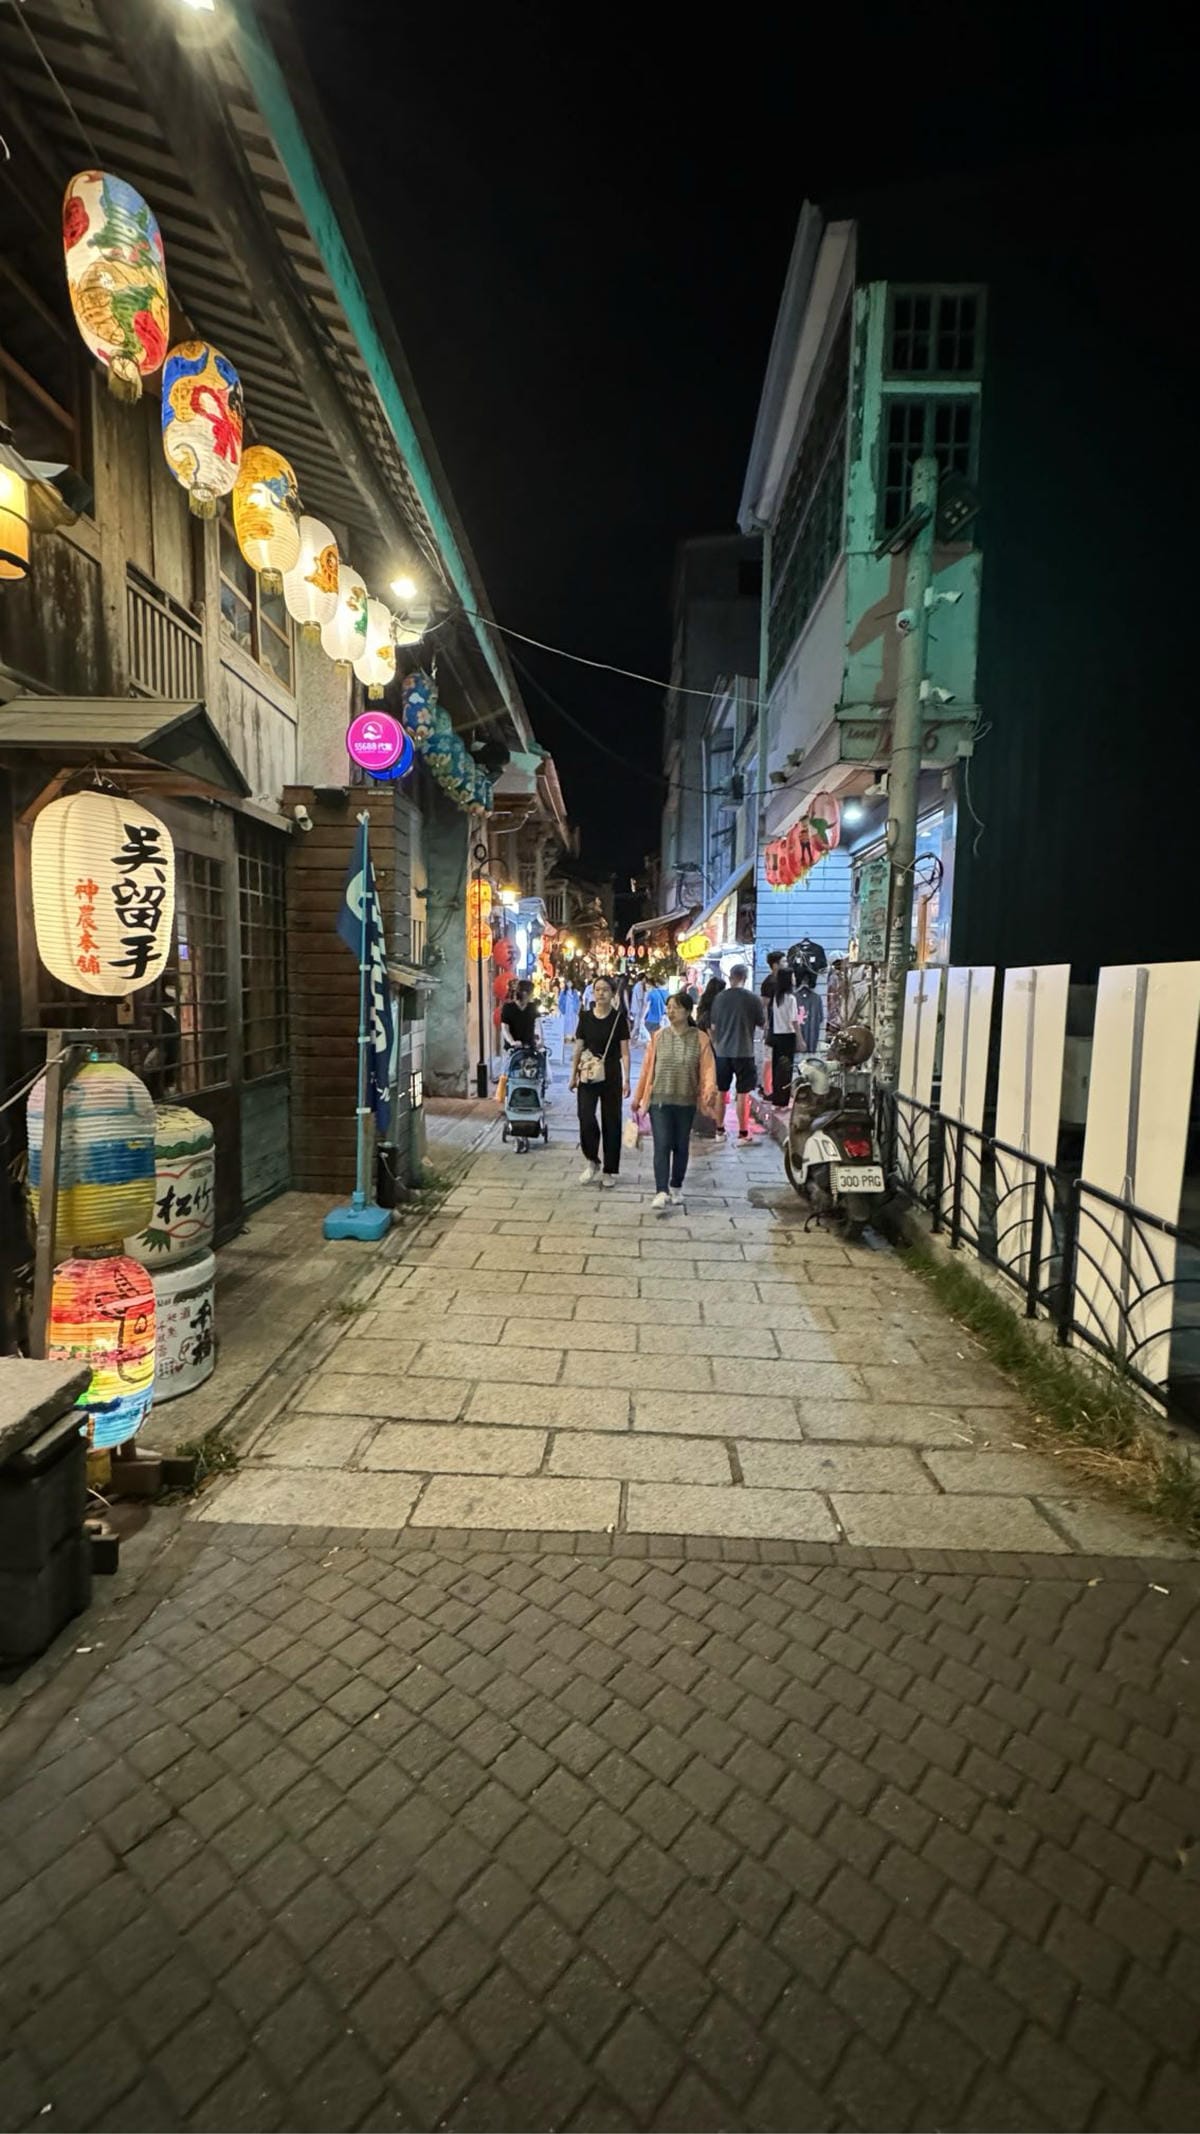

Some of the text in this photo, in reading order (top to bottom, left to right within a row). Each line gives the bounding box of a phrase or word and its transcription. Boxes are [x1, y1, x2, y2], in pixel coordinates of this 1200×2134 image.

[107, 823, 169, 980] 吳留手
[840, 1175, 860, 1188] 300
